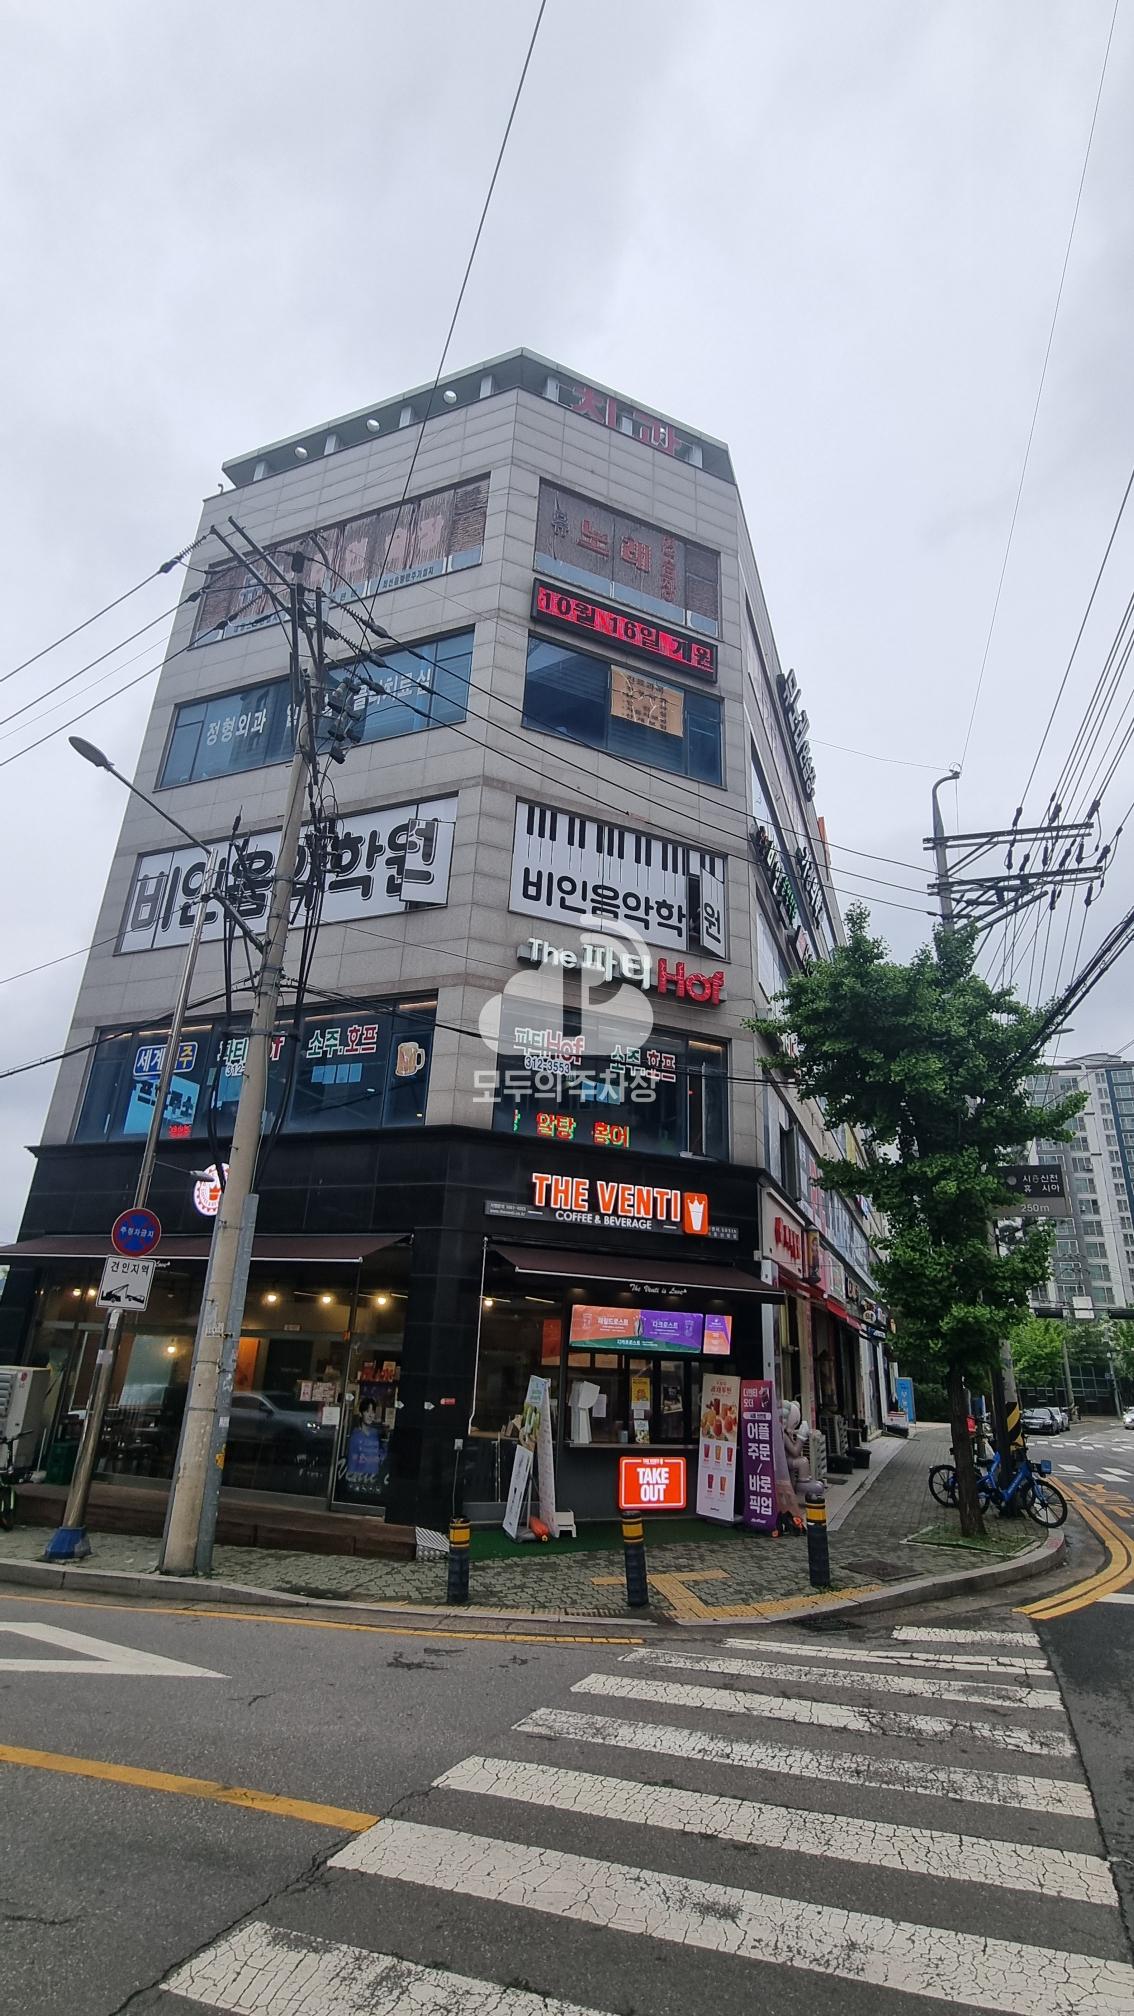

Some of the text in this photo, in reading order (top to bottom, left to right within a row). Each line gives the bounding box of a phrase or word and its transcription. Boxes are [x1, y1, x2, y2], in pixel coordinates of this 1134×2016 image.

[576, 520, 652, 573] 노래
[543, 590, 595, 624] 10월
[611, 617, 659, 649] 16일
[206, 708, 267, 746] 정형외과
[528, 938, 725, 1006] The 파티 Hof
[137, 1045, 193, 1071] 세계주
[524, 1057, 570, 1075] 312-3553
[532, 1172, 681, 1223] THE VENTI
[1021, 1203, 1050, 1213] 250m
[555, 1210, 653, 1230] COFFEE & BEVERAGE
[110, 1261, 150, 1276] 견인지역
[748, 1442, 771, 1461] 주문
[636, 1467, 670, 1484] TAKE
[749, 1474, 772, 1493] 바로
[640, 1485, 666, 1502] OUT
[750, 1496, 772, 1515] 픽업
